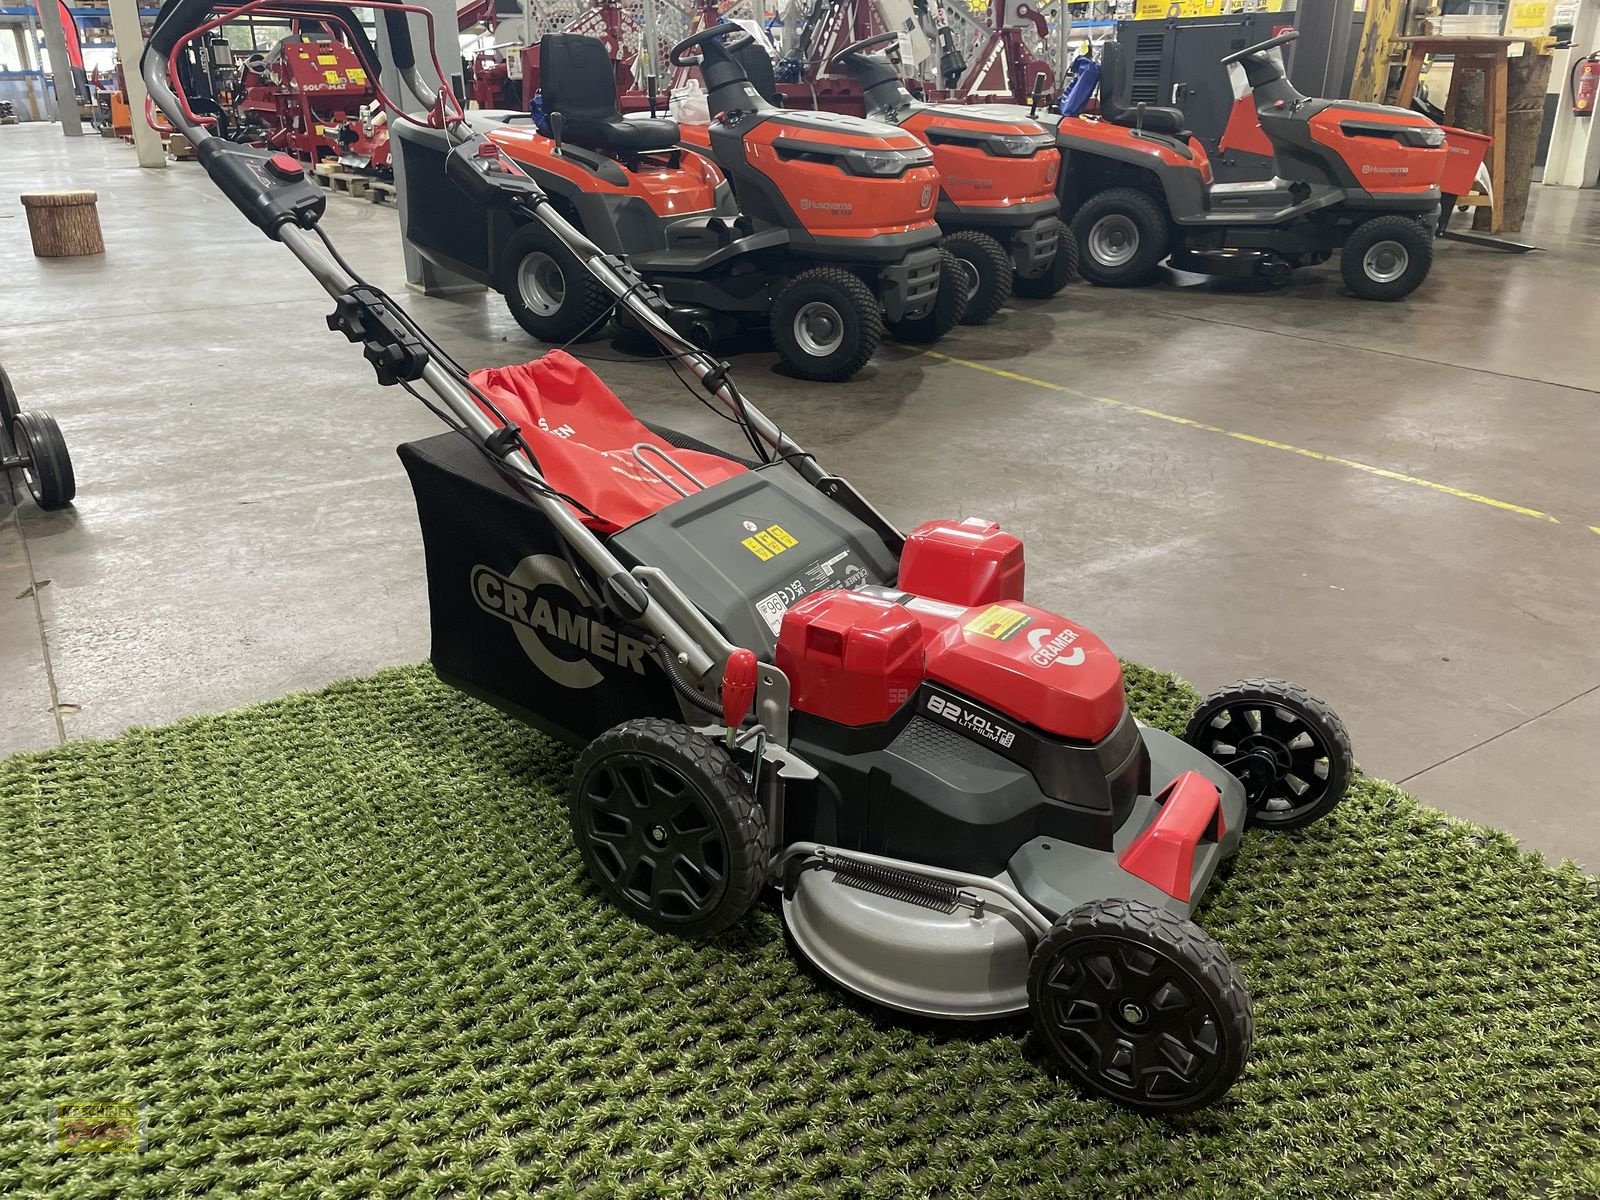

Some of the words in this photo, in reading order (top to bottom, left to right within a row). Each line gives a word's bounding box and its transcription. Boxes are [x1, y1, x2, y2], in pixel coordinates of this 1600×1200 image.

[1370, 166, 1409, 175] Husqvarna
[808, 200, 853, 211] Husqvarna
[844, 568, 868, 588] CRAMER
[777, 586, 796, 605] CE
[767, 598, 783, 614] 96
[477, 573, 646, 676] CRAMER
[1032, 628, 1080, 666] CRAMER
[926, 694, 962, 723] 82
[963, 710, 1008, 738] VOLT
[958, 718, 999, 742] LITHIUM
